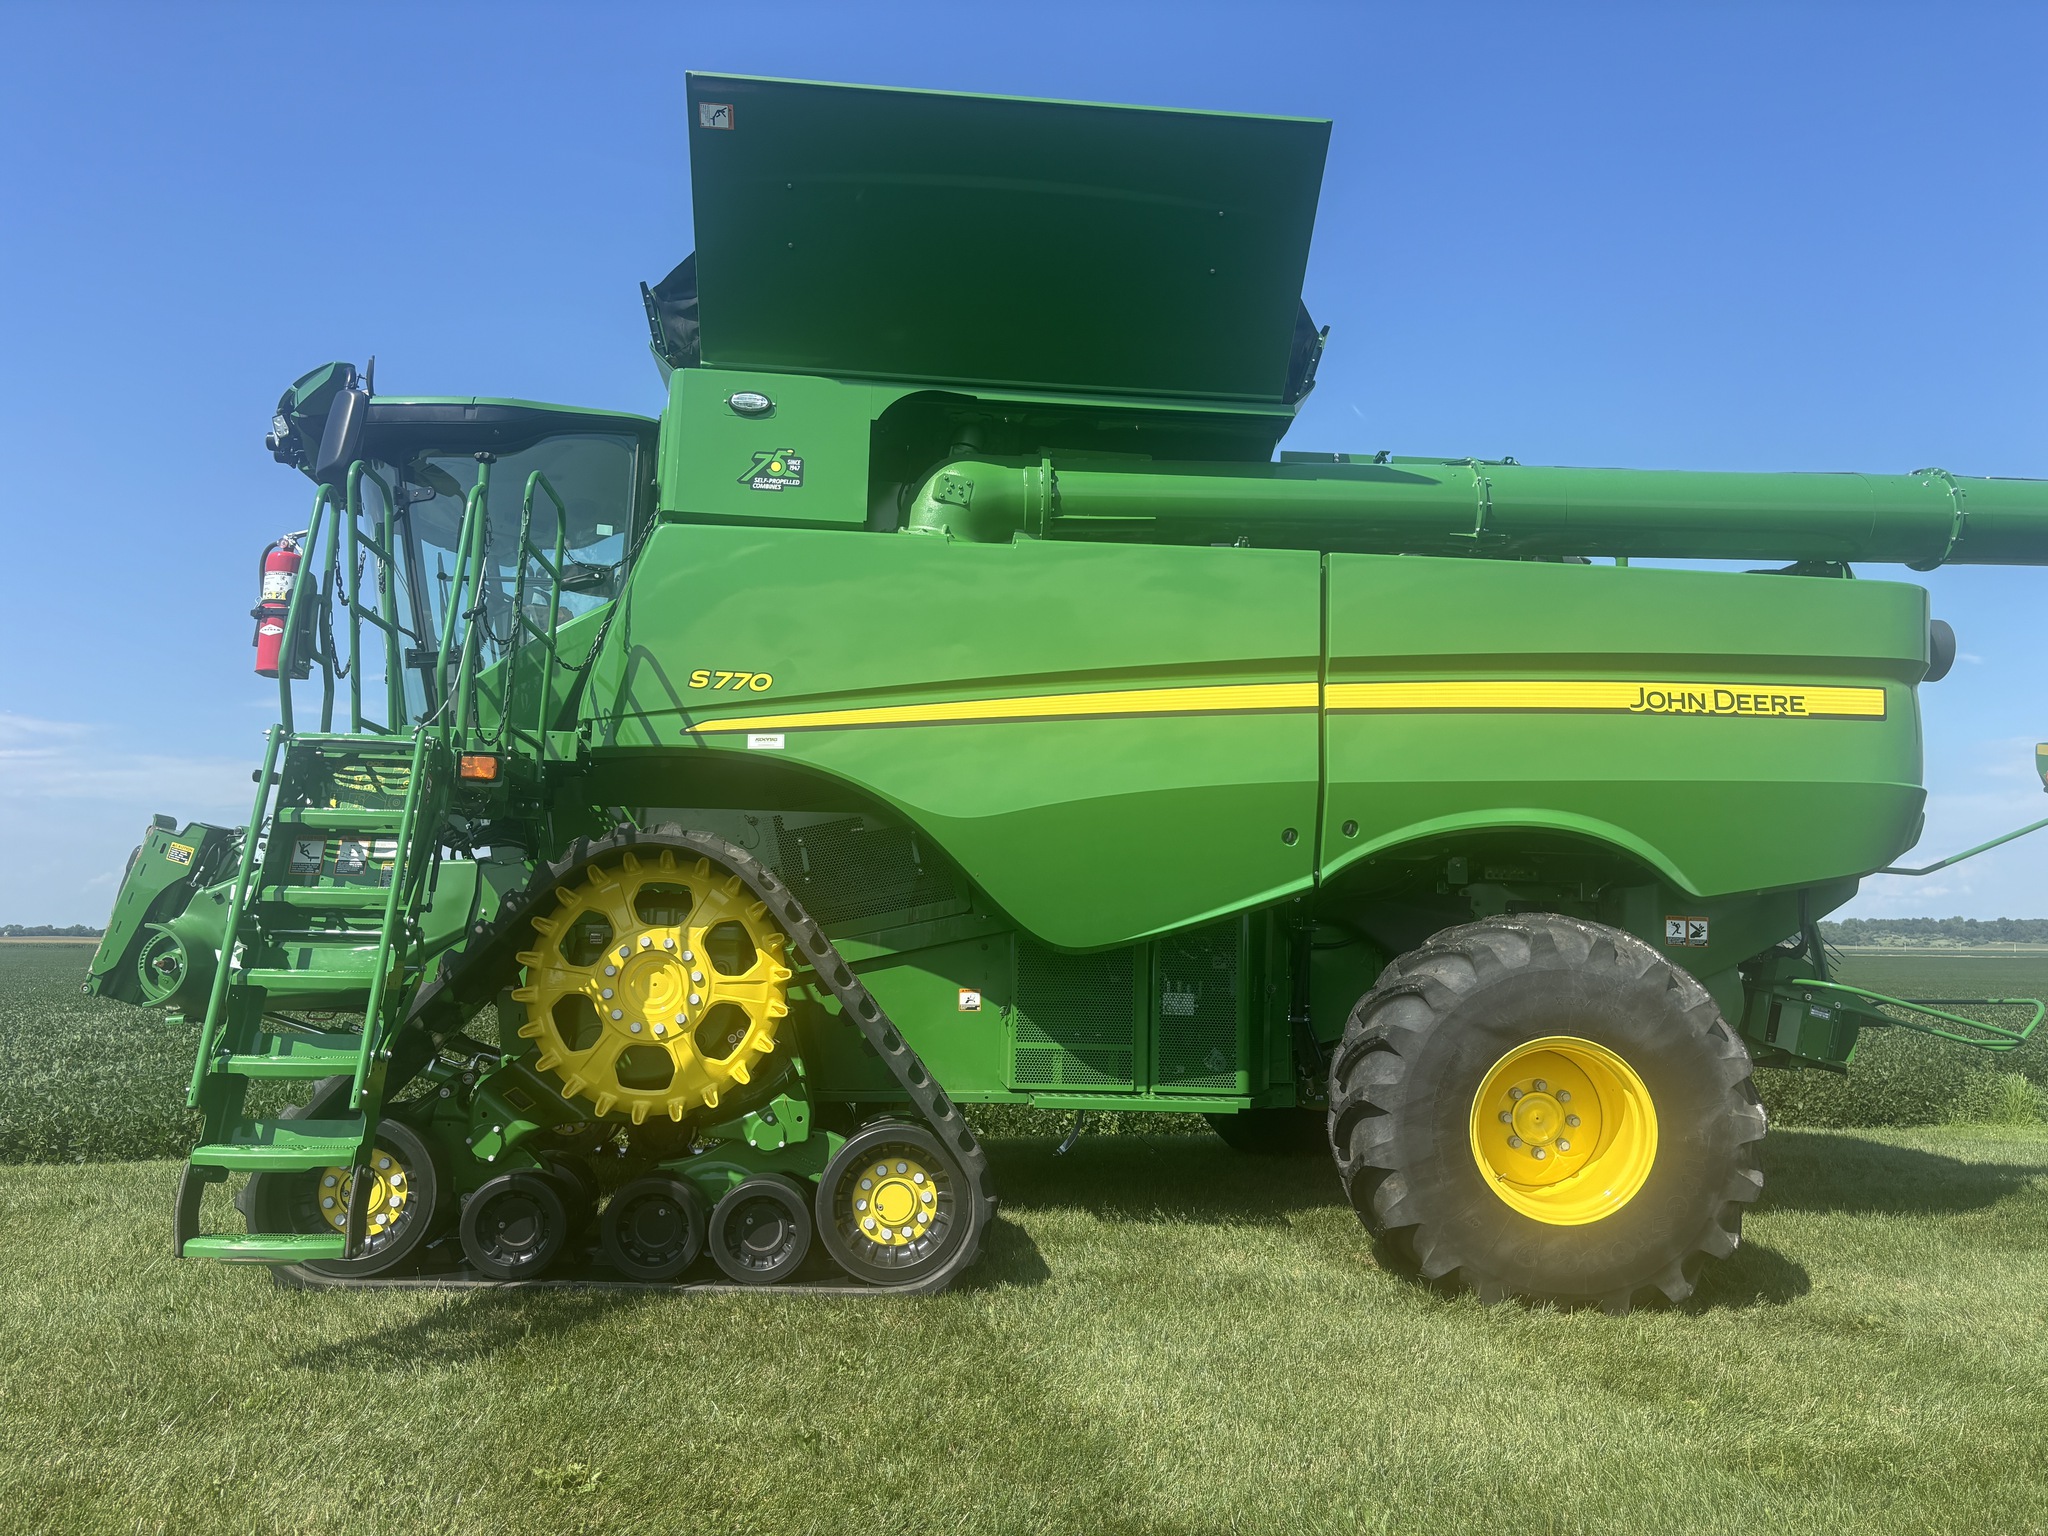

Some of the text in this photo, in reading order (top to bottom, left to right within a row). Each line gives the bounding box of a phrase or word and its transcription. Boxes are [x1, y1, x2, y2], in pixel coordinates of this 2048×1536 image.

[740, 449, 794, 482] 75
[754, 477, 800, 486] SELF-PROPELLED
[688, 669, 773, 692] S770
[1630, 687, 1806, 713] JOHN DEERE
